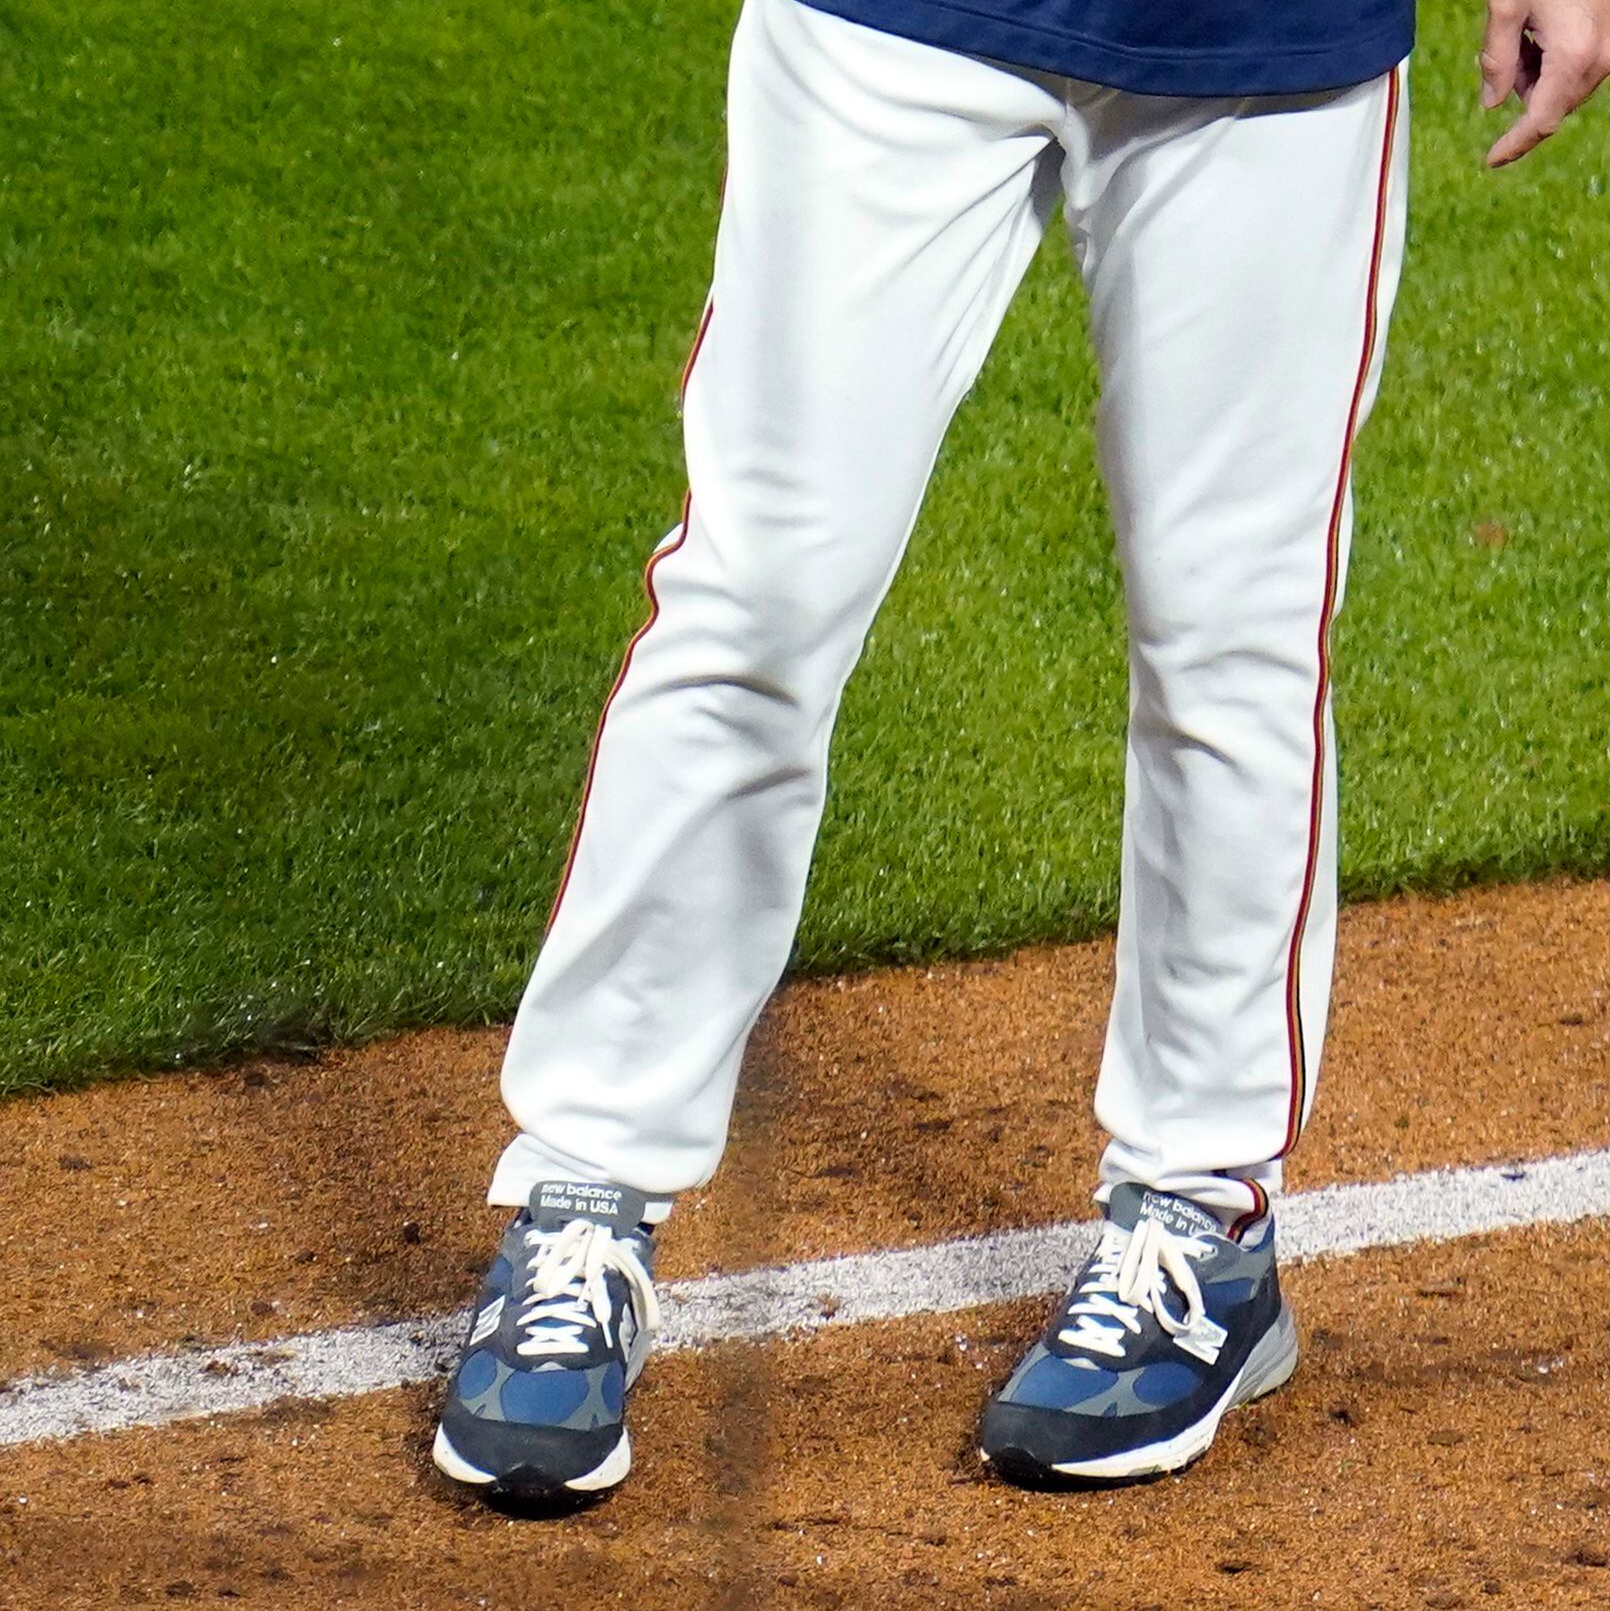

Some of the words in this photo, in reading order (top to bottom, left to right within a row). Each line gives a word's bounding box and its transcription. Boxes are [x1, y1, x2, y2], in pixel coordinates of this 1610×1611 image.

[566, 1182, 622, 1201] balance
[540, 1194, 572, 1209] Made
[575, 1198, 587, 1211] in
[589, 1199, 619, 1215] USA
[1140, 1201, 1174, 1224] Made
[1175, 1216, 1188, 1231] in
[1172, 1198, 1217, 1233] balance
